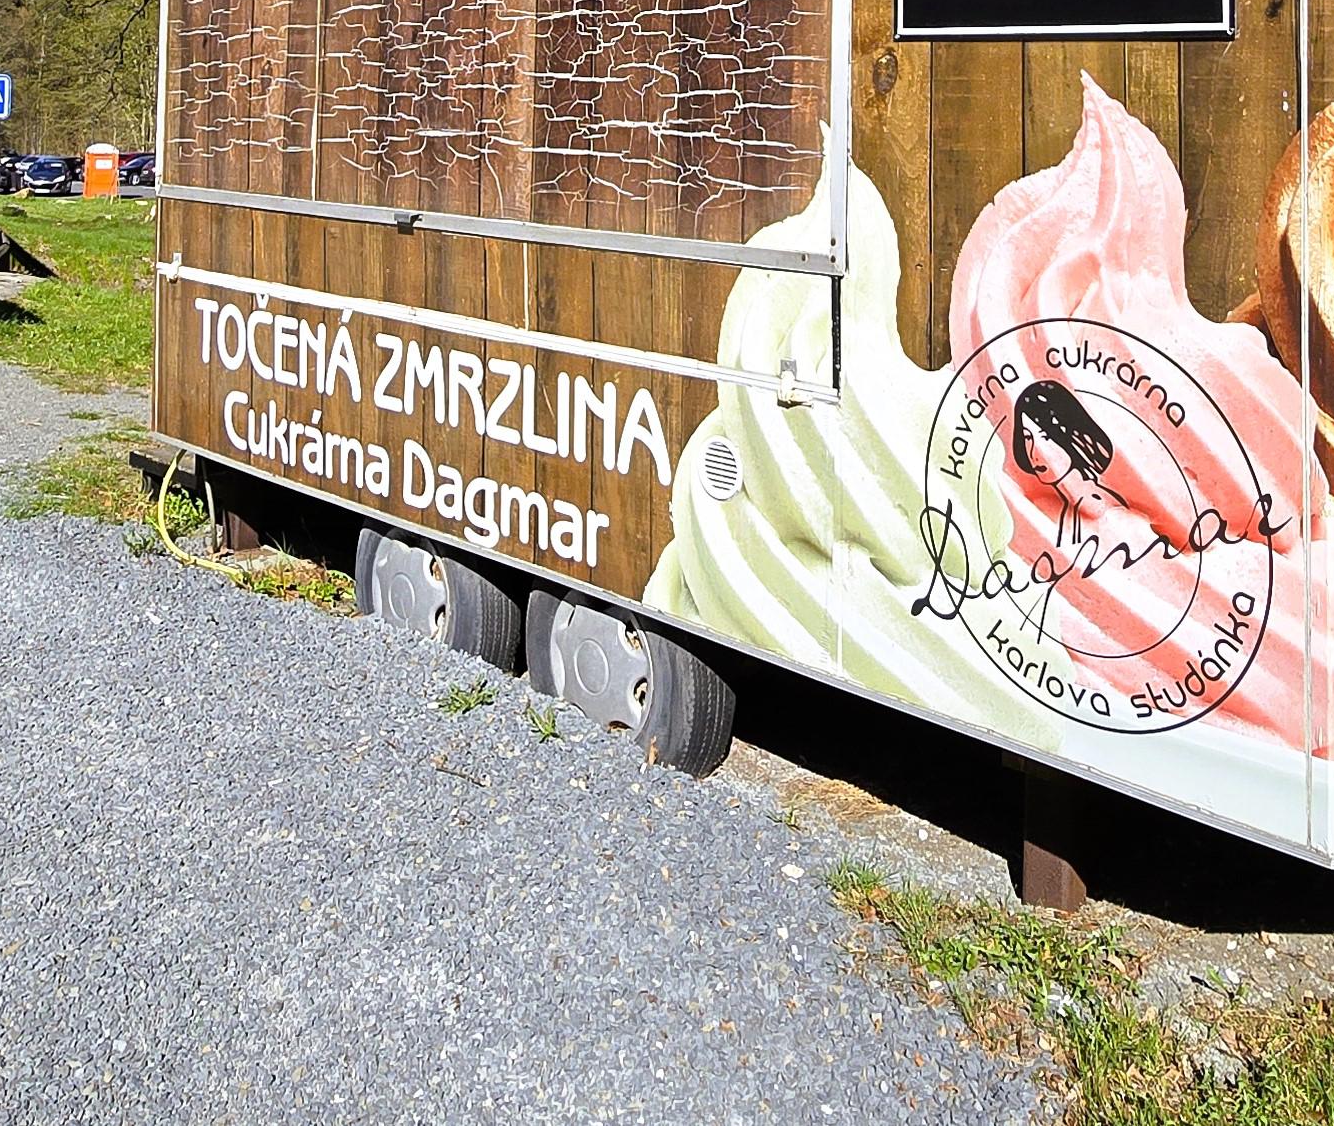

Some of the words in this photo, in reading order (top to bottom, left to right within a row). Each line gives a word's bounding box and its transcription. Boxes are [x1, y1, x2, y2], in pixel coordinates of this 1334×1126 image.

[194, 293, 362, 403] TOČENÁ
[373, 332, 672, 487] ZMRZLINA
[940, 362, 1020, 480] kavárna
[1045, 340, 1186, 428] cukrárna
[223, 390, 391, 499] Cukrárna
[403, 436, 611, 569] Dagmar
[910, 493, 1294, 645] Dagmar
[985, 618, 1111, 718] karlova
[1130, 590, 1256, 719] studánka
